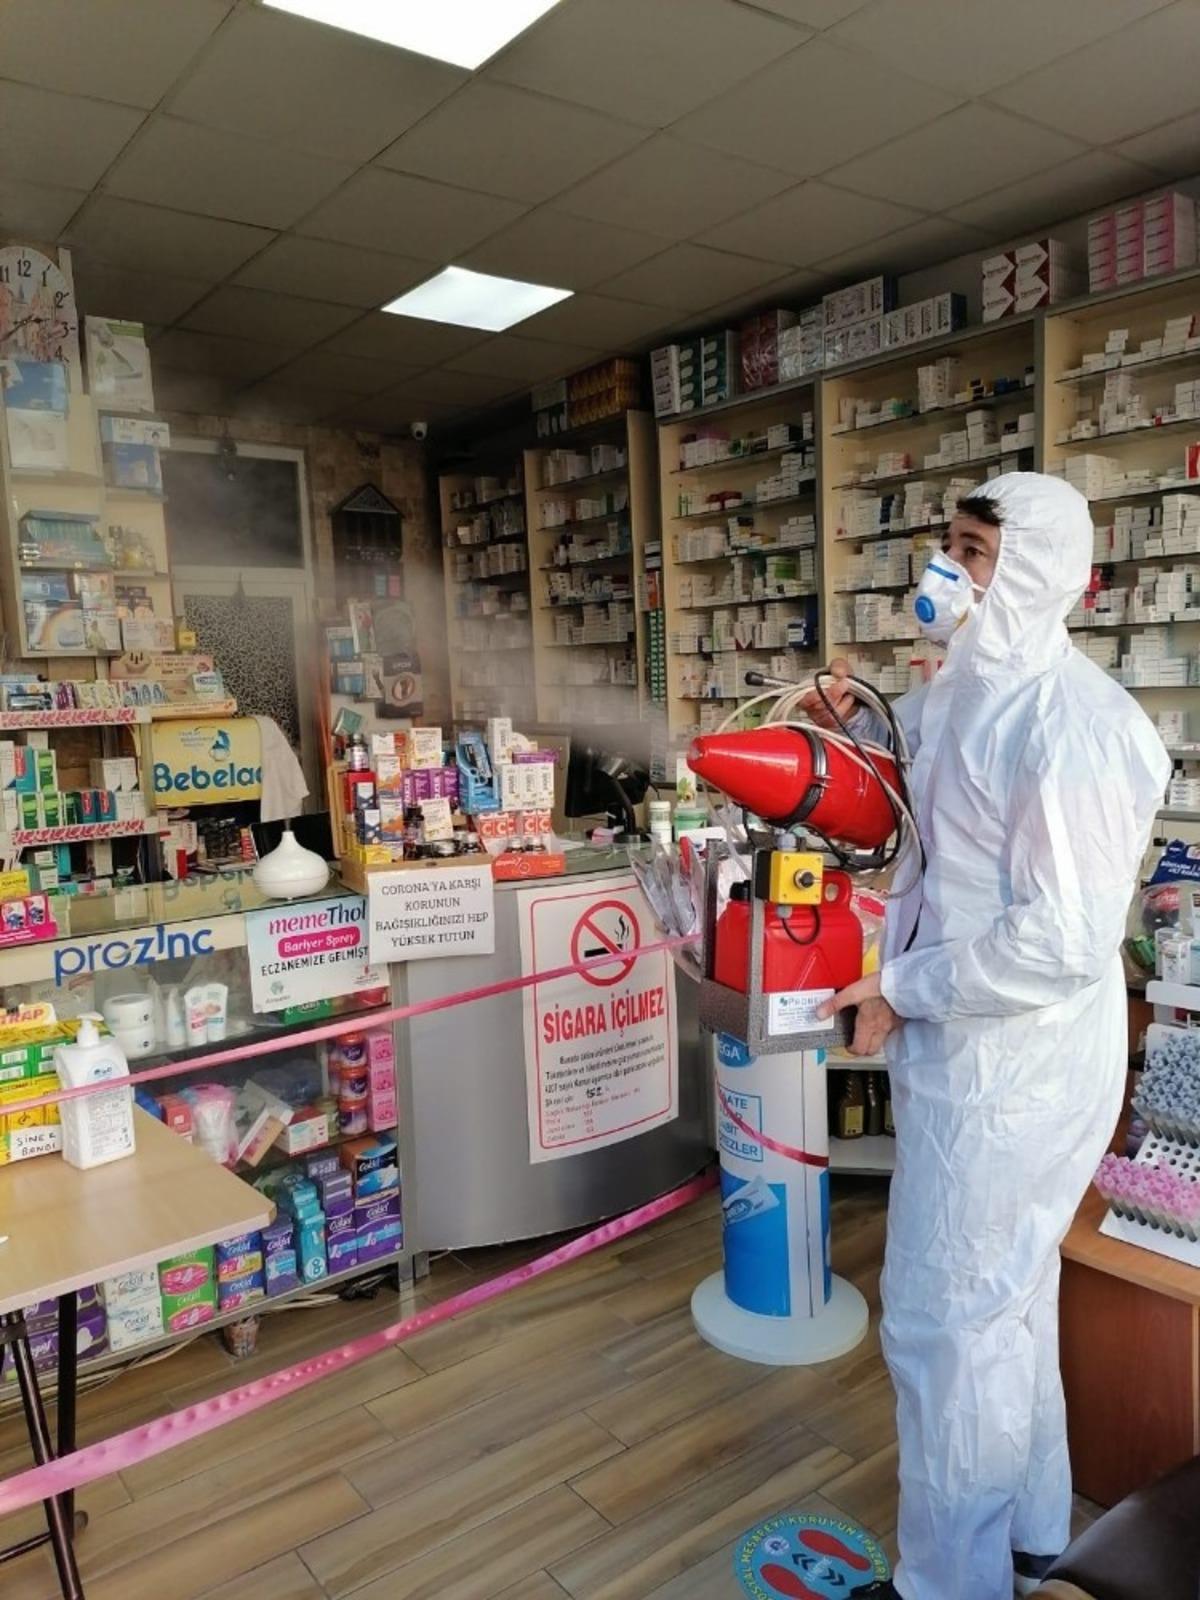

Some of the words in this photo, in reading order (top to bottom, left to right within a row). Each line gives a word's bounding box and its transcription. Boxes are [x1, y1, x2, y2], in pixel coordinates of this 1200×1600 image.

[17, 259, 32, 278] 12
[55, 291, 64, 308] 2
[61, 322, 69, 338] 3
[449, 877, 481, 891] KARŞI
[405, 897, 460, 912] KORUNUN
[269, 899, 367, 936] memeThol
[468, 911, 489, 924] HEP
[284, 936, 324, 954] Bariyer
[326, 931, 356, 949] Sprey
[391, 932, 435, 948] YÜKSEK
[438, 930, 475, 944] TUTUN
[543, 1003, 606, 1044] SİGARA
[611, 987, 665, 1037] İÇİLMEZ
